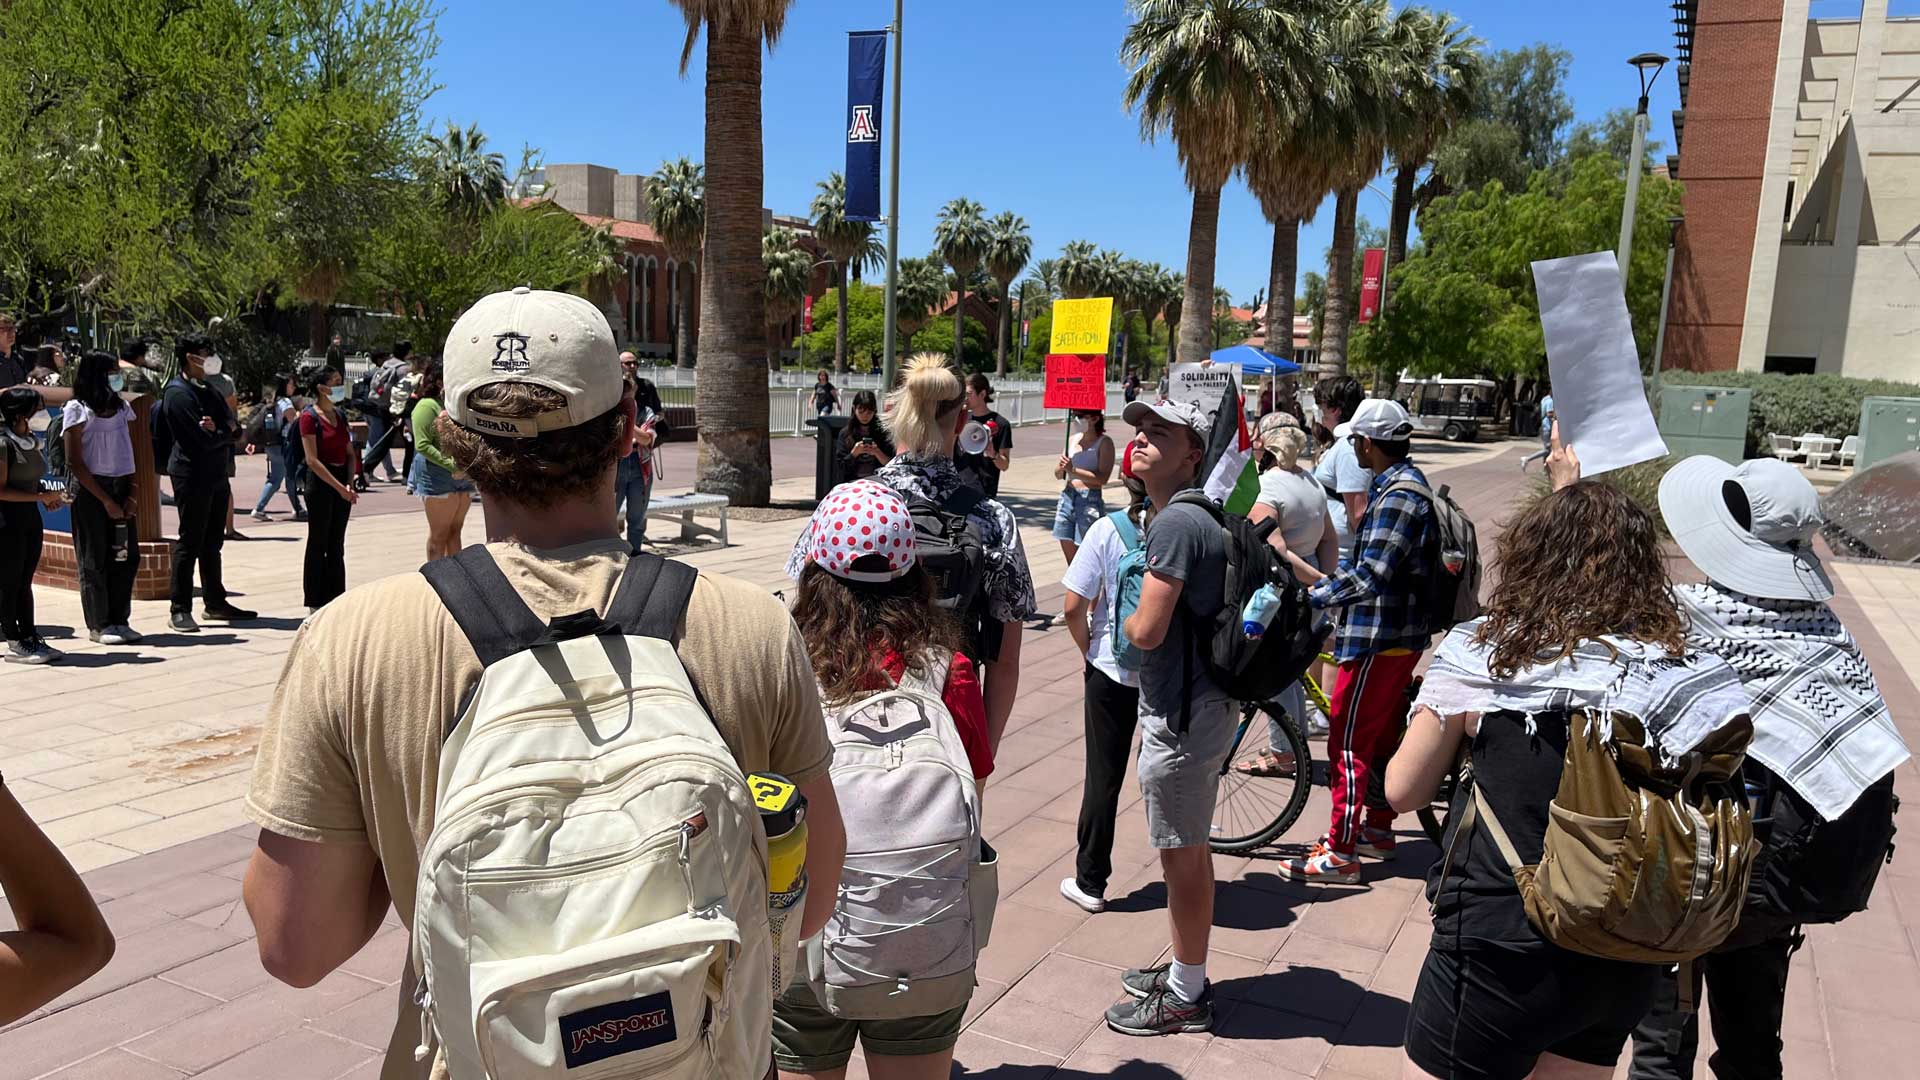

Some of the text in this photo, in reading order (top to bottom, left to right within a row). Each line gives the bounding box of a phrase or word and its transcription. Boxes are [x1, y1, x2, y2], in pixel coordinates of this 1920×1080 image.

[848, 105, 878, 143] A
[1181, 371, 1229, 381] SOLIDARITY
[476, 418, 519, 433] ESPAÑA
[571, 1009, 666, 1054] JANSPORT
